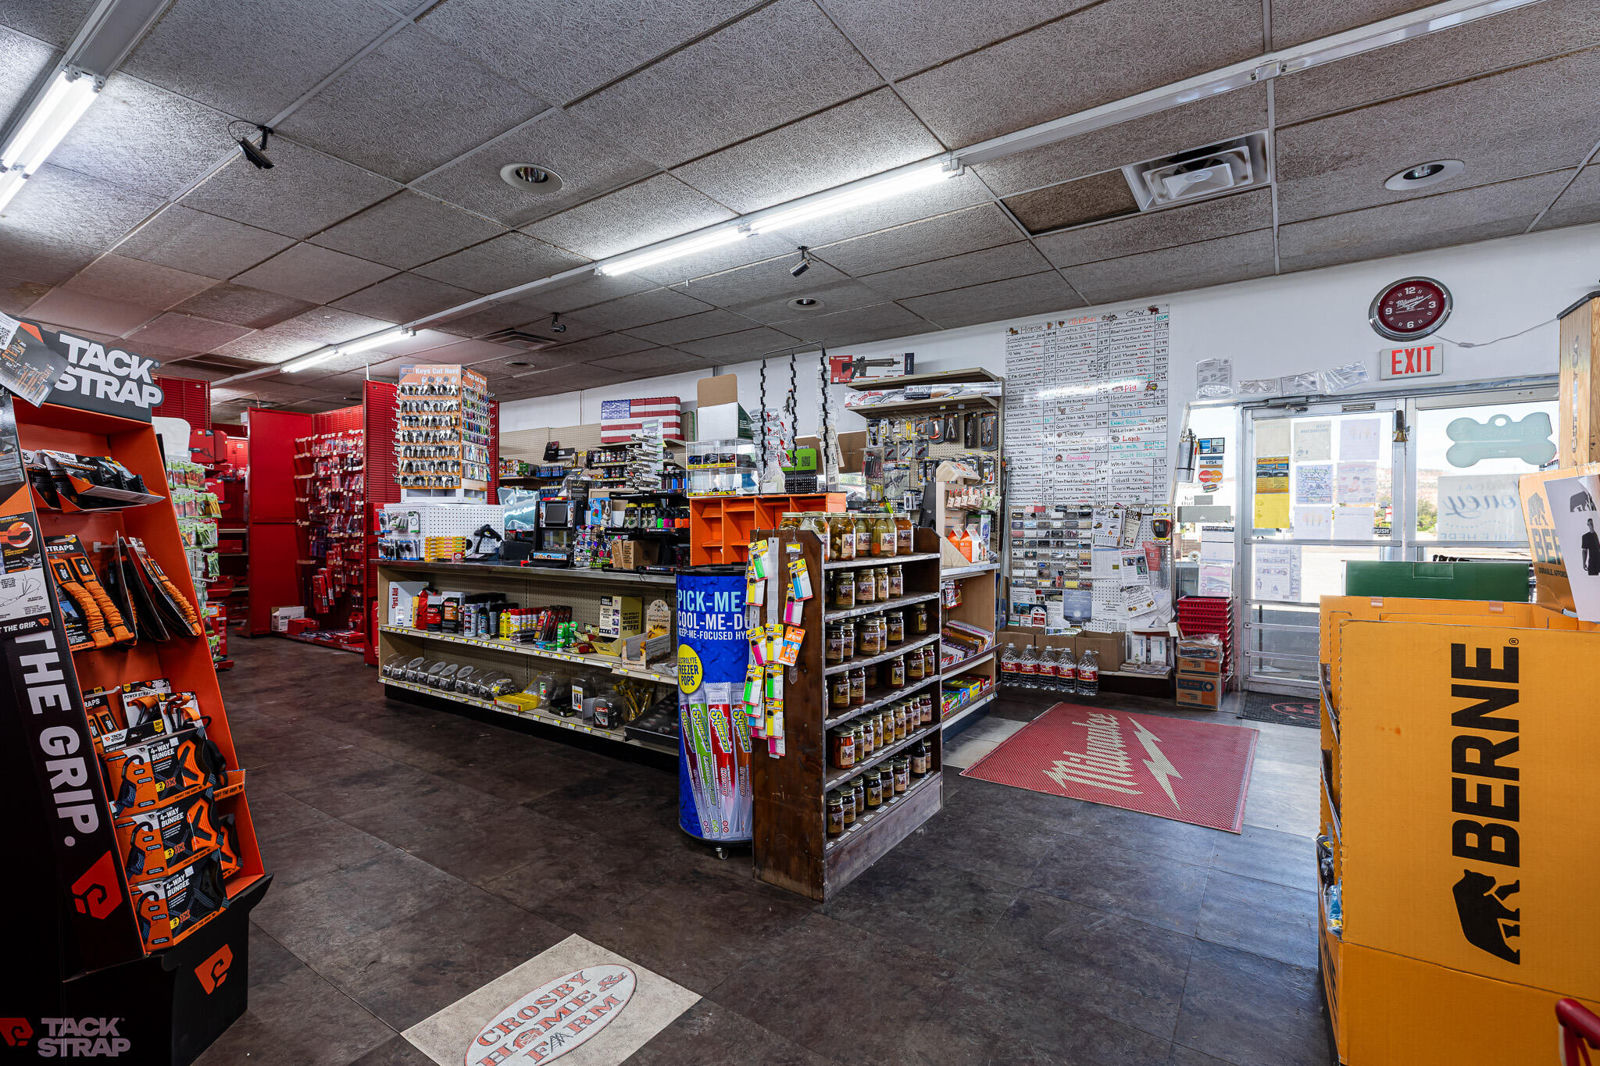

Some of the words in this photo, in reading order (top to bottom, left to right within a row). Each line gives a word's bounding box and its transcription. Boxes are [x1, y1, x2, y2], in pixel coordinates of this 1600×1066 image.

[1404, 286, 1416, 295] 12
[1385, 307, 1393, 315] 9
[1428, 300, 1437, 309] 3
[1020, 326, 1043, 335] Horse
[1406, 321, 1415, 329] 6
[59, 333, 155, 383] TACK
[1391, 345, 1435, 375] EXIT
[415, 367, 431, 376] Keys
[432, 367, 443, 375] Cut
[55, 365, 163, 408] STRAP
[1124, 384, 1137, 393] Pig
[45, 544, 75, 553] STRAPS
[3, 623, 18, 633] THE
[19, 620, 38, 630] GRIP.
[678, 628, 733, 640] EEP-ME-FOCUSED
[15, 630, 72, 715] THE
[681, 674, 696, 686] POPS
[84, 698, 101, 708] RAPS
[150, 742, 170, 755] 4-WAY
[151, 748, 175, 761] BUNGEE
[1451, 642, 1520, 868] BERNE
[40, 725, 101, 848] GRIP.
[160, 807, 180, 820] 4-WAY
[161, 812, 184, 828] BUNGEE
[166, 874, 185, 890] 4-WAY
[167, 879, 190, 898] BUNGEE
[597, 970, 629, 993] &
[476, 970, 592, 1047] CROSBY
[41, 1017, 121, 1037] TACK
[37, 1037, 131, 1058] STRAP
